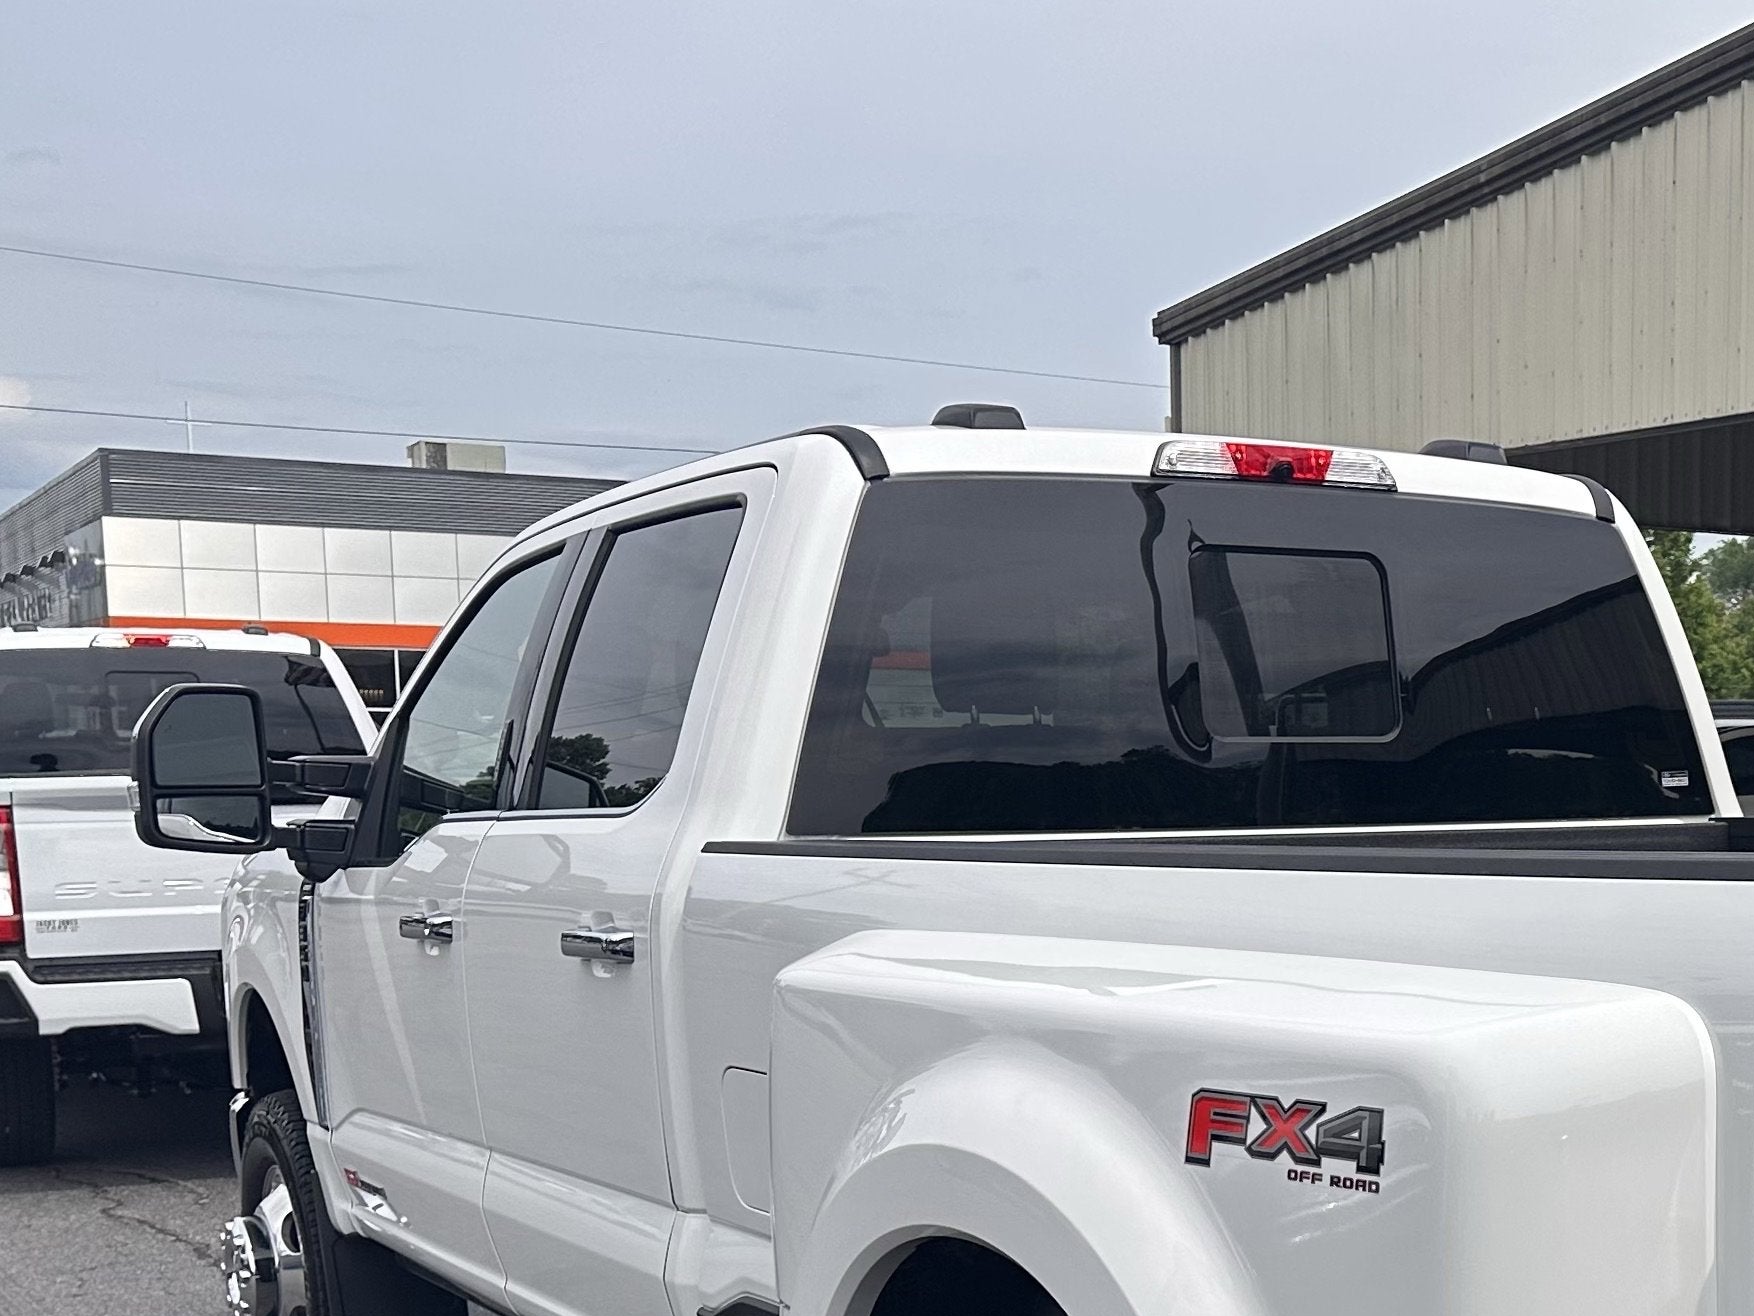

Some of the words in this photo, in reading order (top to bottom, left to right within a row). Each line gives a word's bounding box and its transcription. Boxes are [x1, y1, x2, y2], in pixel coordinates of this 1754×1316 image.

[1184, 1087, 1386, 1177] FX4
[1287, 1168, 1323, 1185] OFF
[1329, 1174, 1381, 1194] ROAD
